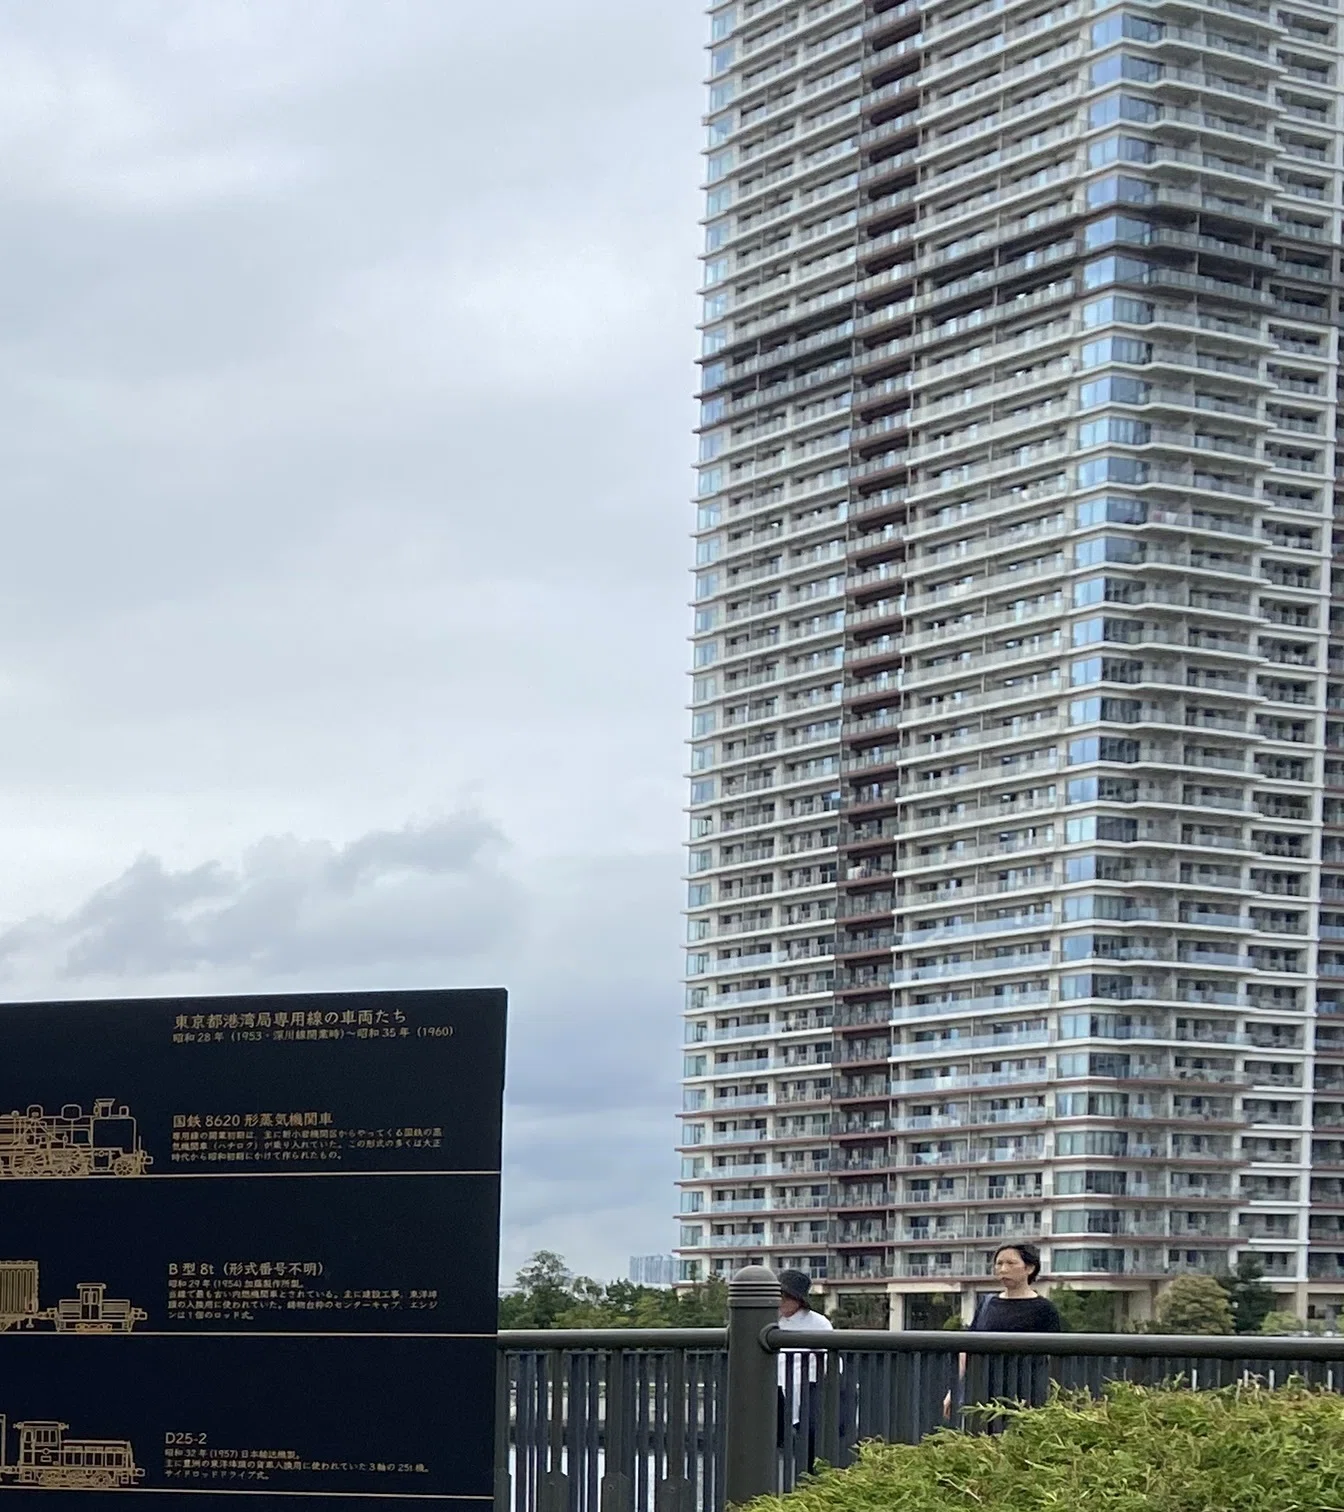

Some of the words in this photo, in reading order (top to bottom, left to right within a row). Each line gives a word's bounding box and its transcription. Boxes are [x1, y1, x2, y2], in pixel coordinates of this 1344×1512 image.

[173, 1008, 407, 1030] 東京都港湾局専用線の車両たち
[165, 1432, 208, 1445] D25-2
